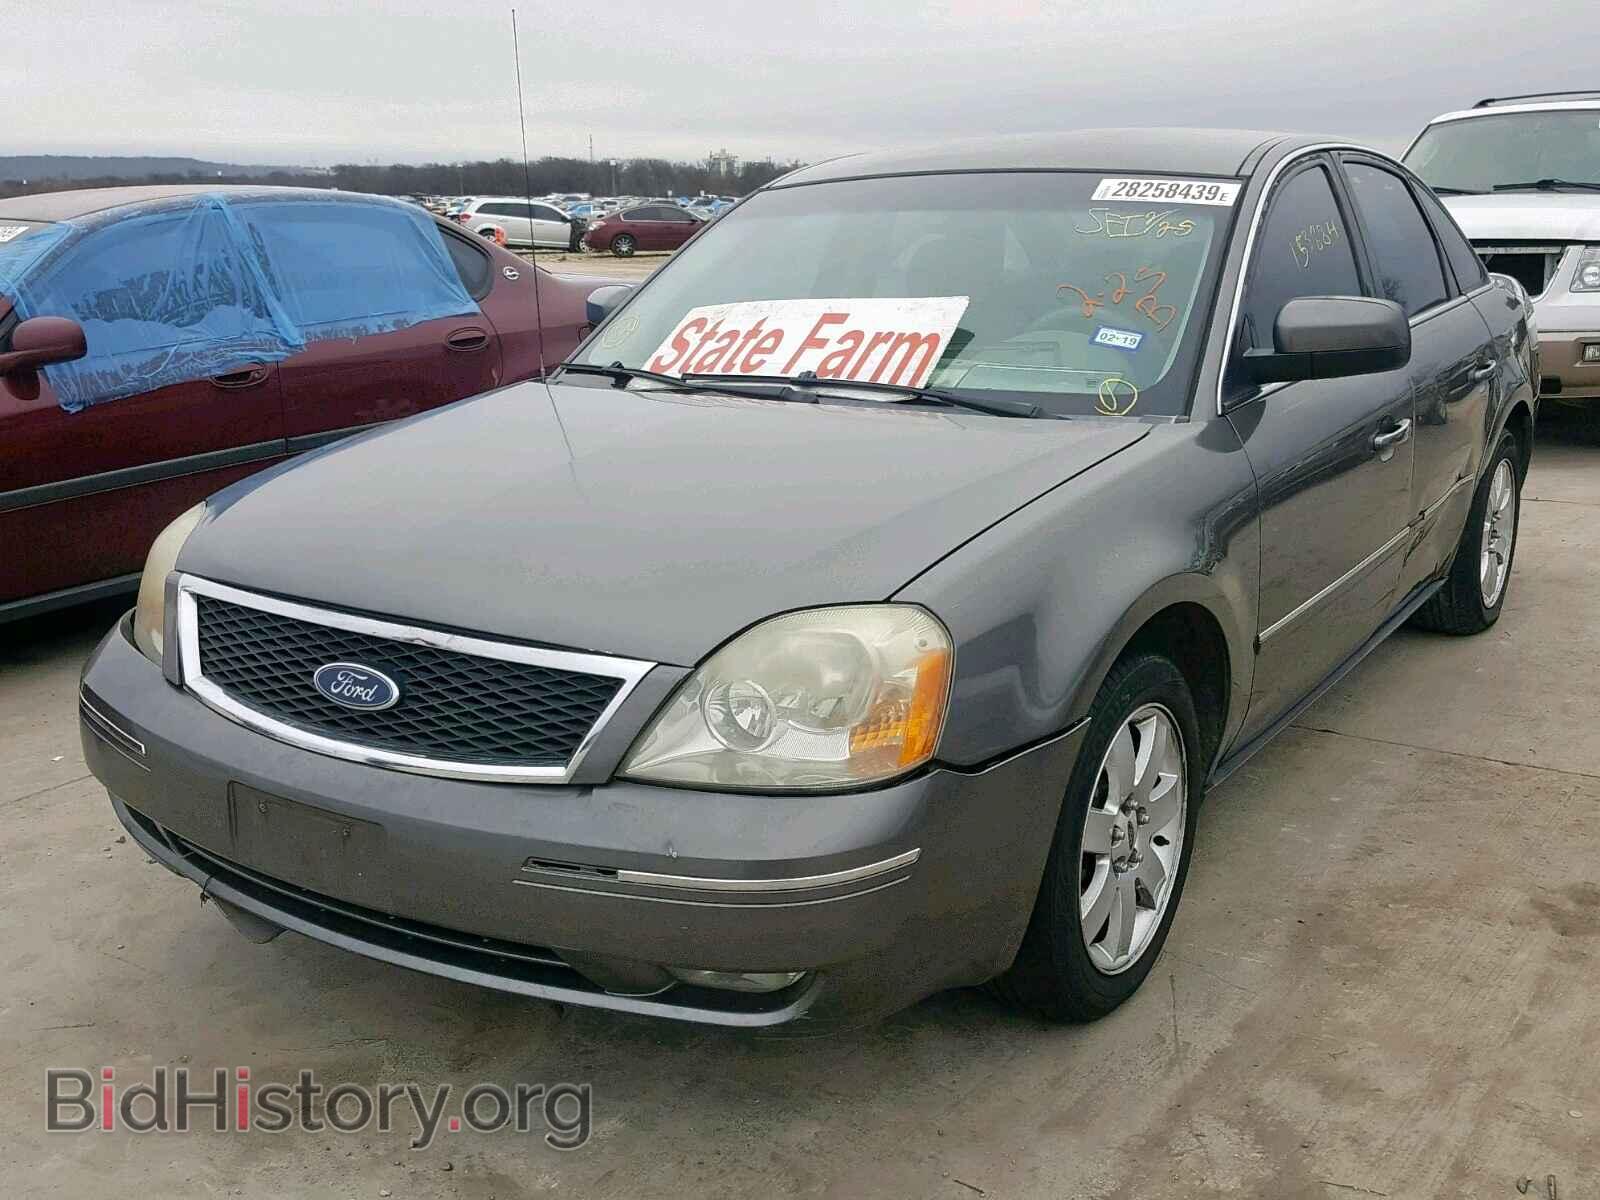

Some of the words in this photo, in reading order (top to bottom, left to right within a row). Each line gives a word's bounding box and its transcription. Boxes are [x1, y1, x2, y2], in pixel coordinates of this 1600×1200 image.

[1111, 181, 1221, 202] 28258439
[649, 316, 785, 375] State
[780, 312, 941, 388] Farm
[331, 670, 379, 702] Ford
